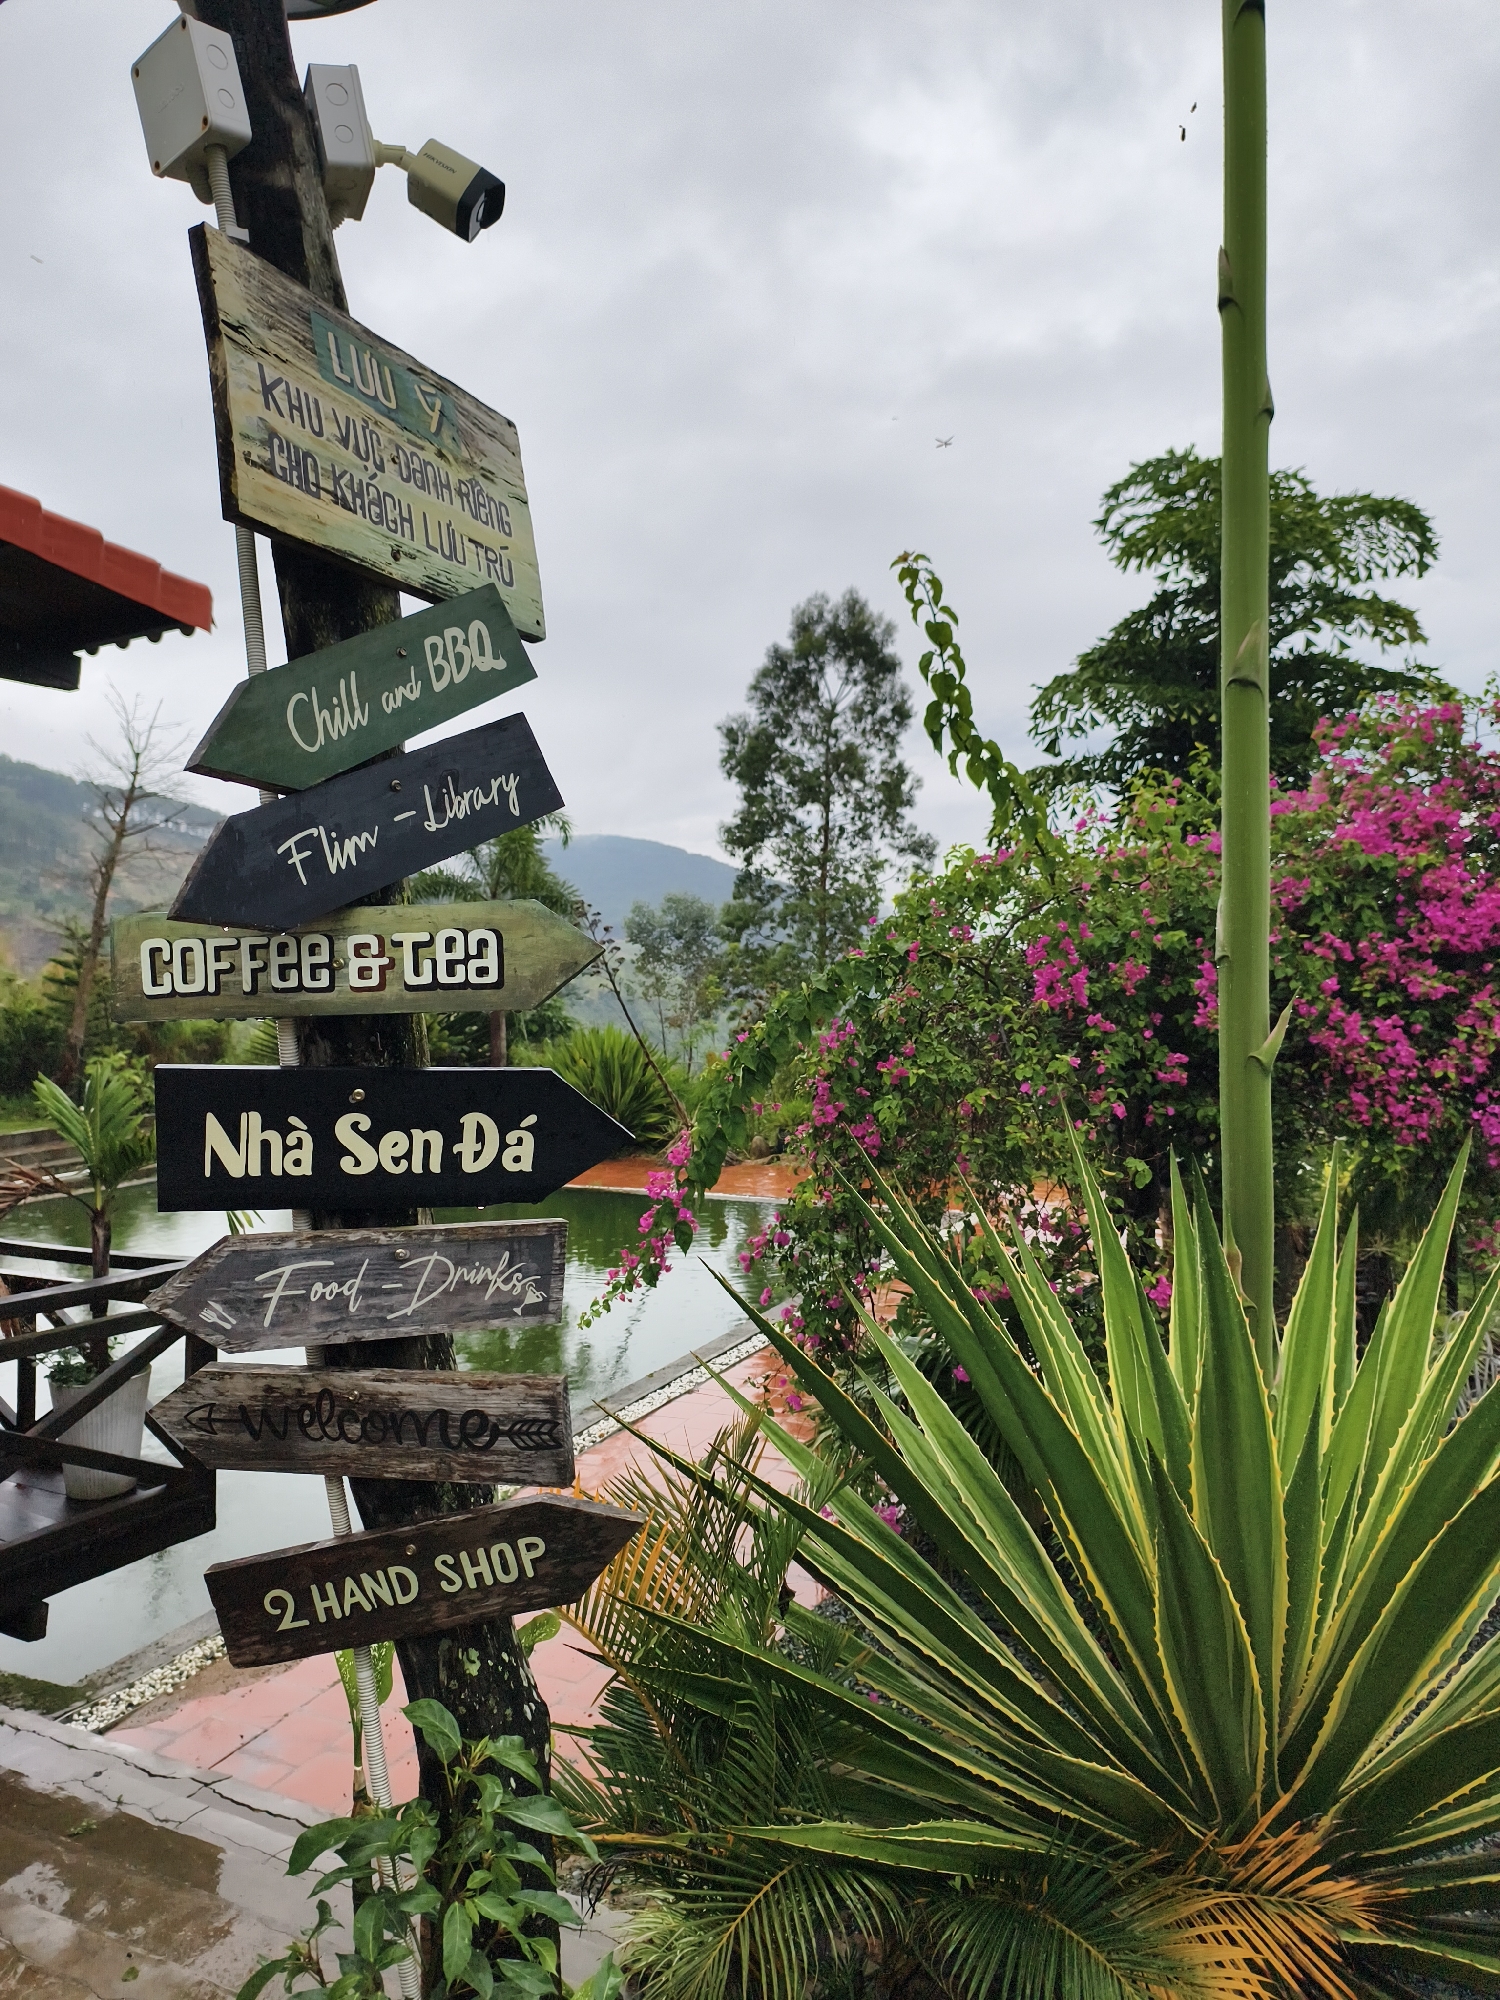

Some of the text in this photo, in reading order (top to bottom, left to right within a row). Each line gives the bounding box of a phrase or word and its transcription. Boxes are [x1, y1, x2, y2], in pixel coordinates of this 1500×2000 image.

[422, 152, 457, 174] HIKVISION
[257, 361, 325, 438] KHU
[332, 408, 386, 474] VỰC
[268, 431, 322, 499] CHO
[468, 537, 514, 588] TRÚ
[286, 619, 507, 753] Chill and BBQ
[423, 772, 520, 832] Library
[346, 934, 394, 992] &
[204, 1111, 539, 1178] Nhà Sen Đá
[254, 1257, 370, 1328] Food
[386, 1250, 541, 1320] Drinks
[237, 1387, 500, 1451] welcome
[263, 1536, 547, 1632] 2 HAND SHOP
